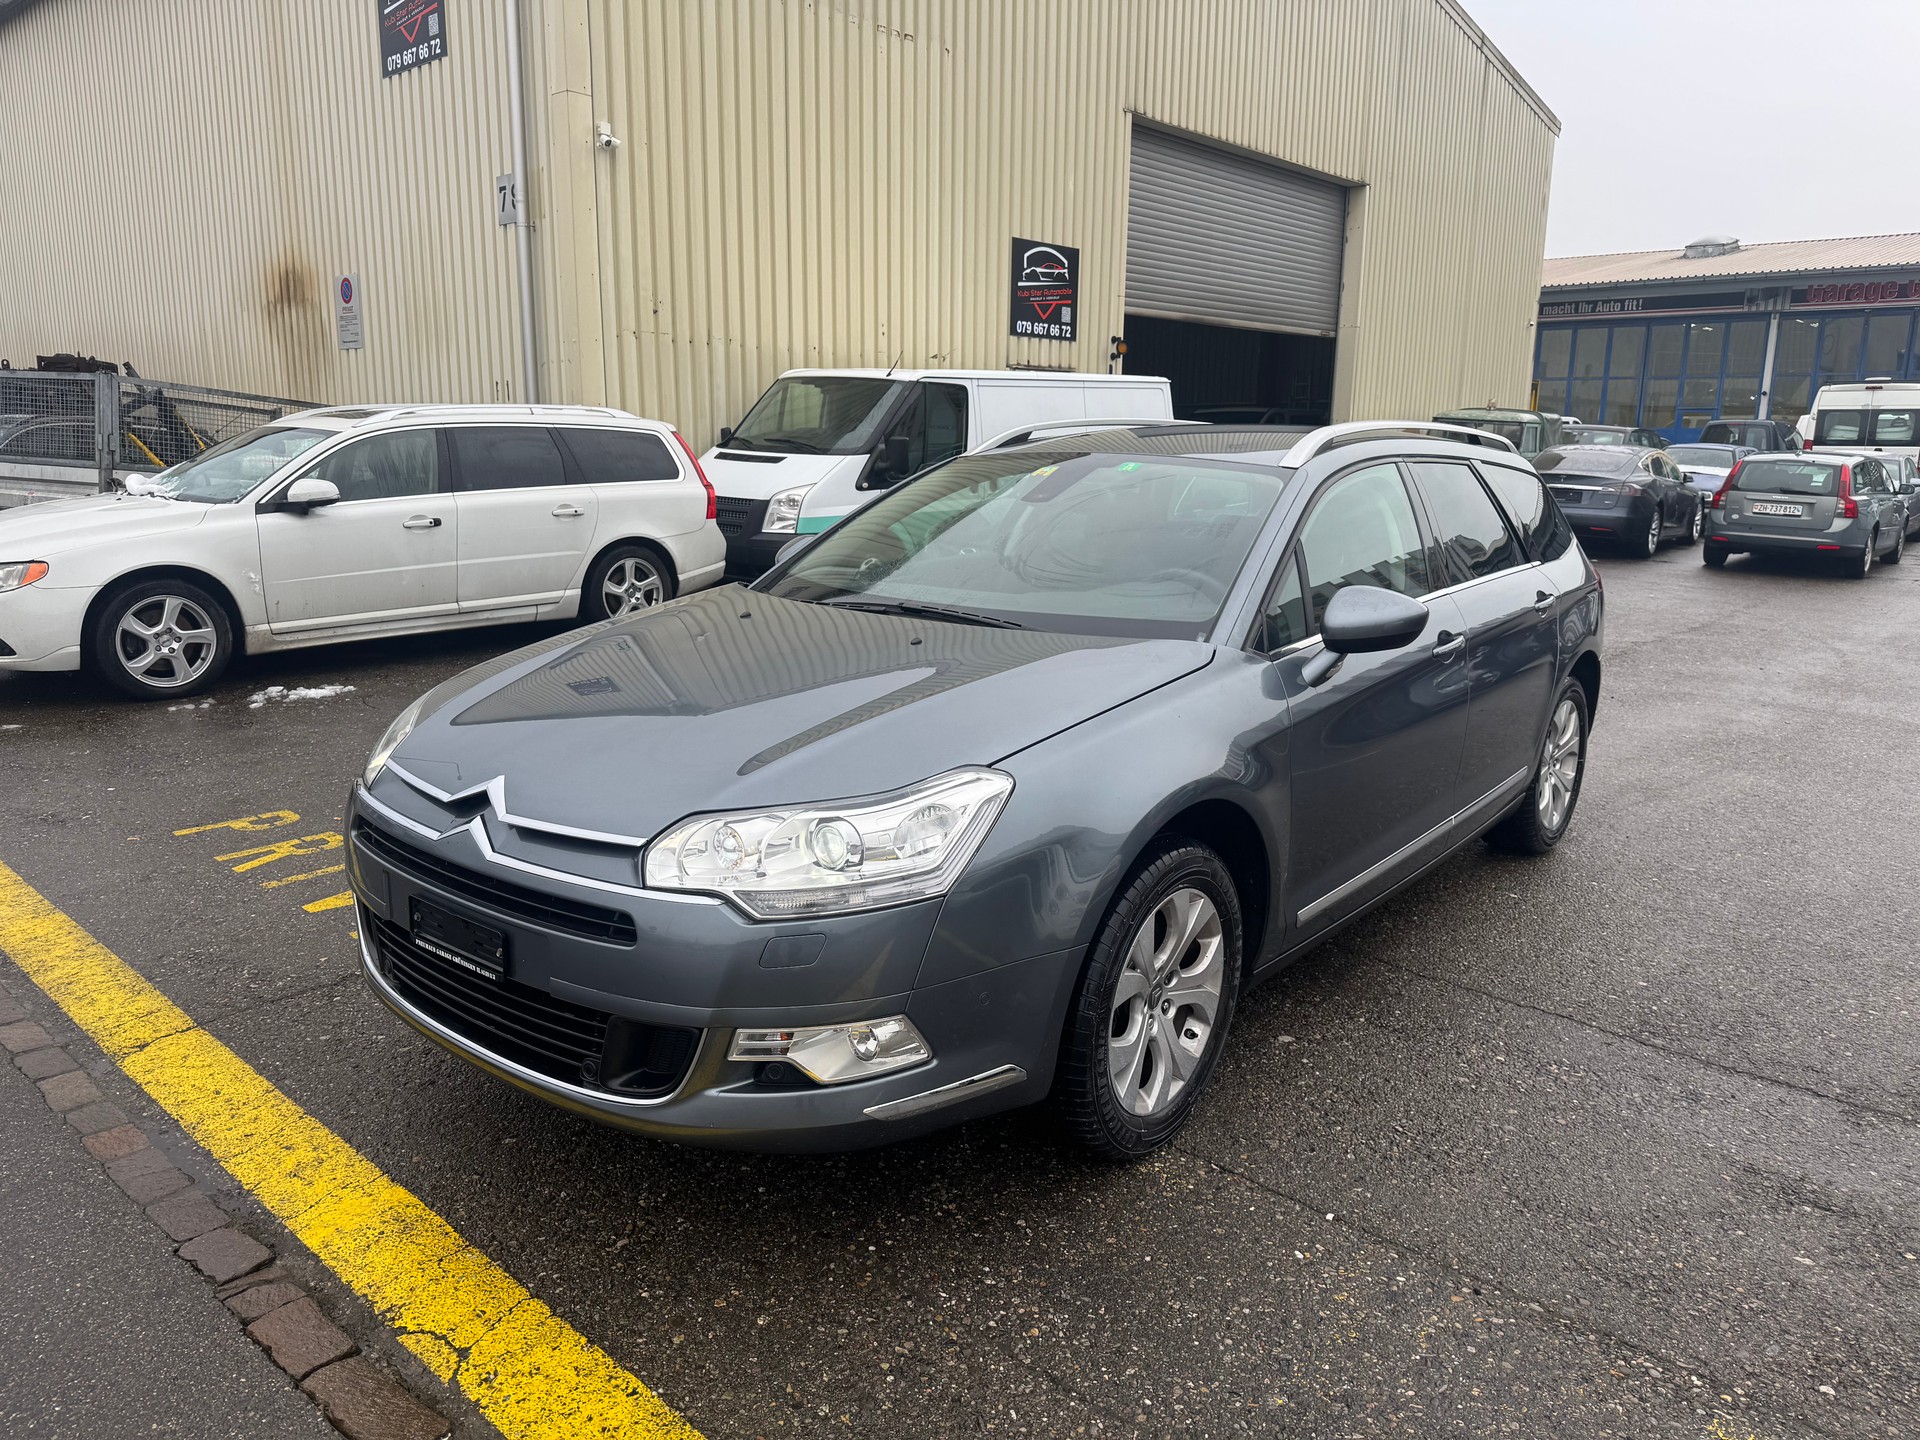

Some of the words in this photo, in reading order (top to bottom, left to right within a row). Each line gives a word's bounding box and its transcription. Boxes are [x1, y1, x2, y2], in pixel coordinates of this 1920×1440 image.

[387, 53, 401, 71] 079
[403, 47, 417, 66] 667
[418, 42, 429, 60] 66
[430, 38, 441, 56] 72
[1031, 289, 1042, 297] Star
[1807, 280, 1899, 304] Garage
[1543, 302, 1575, 315] macht
[1578, 302, 1593, 313] Ihr
[1595, 301, 1621, 312] Auto
[1624, 299, 1643, 311] fit!
[1016, 320, 1032, 334] 079
[1033, 322, 1048, 335] 667
[1050, 323, 1060, 337] 66
[1061, 325, 1071, 338] 72
[436, 947, 452, 960] GARAGE
